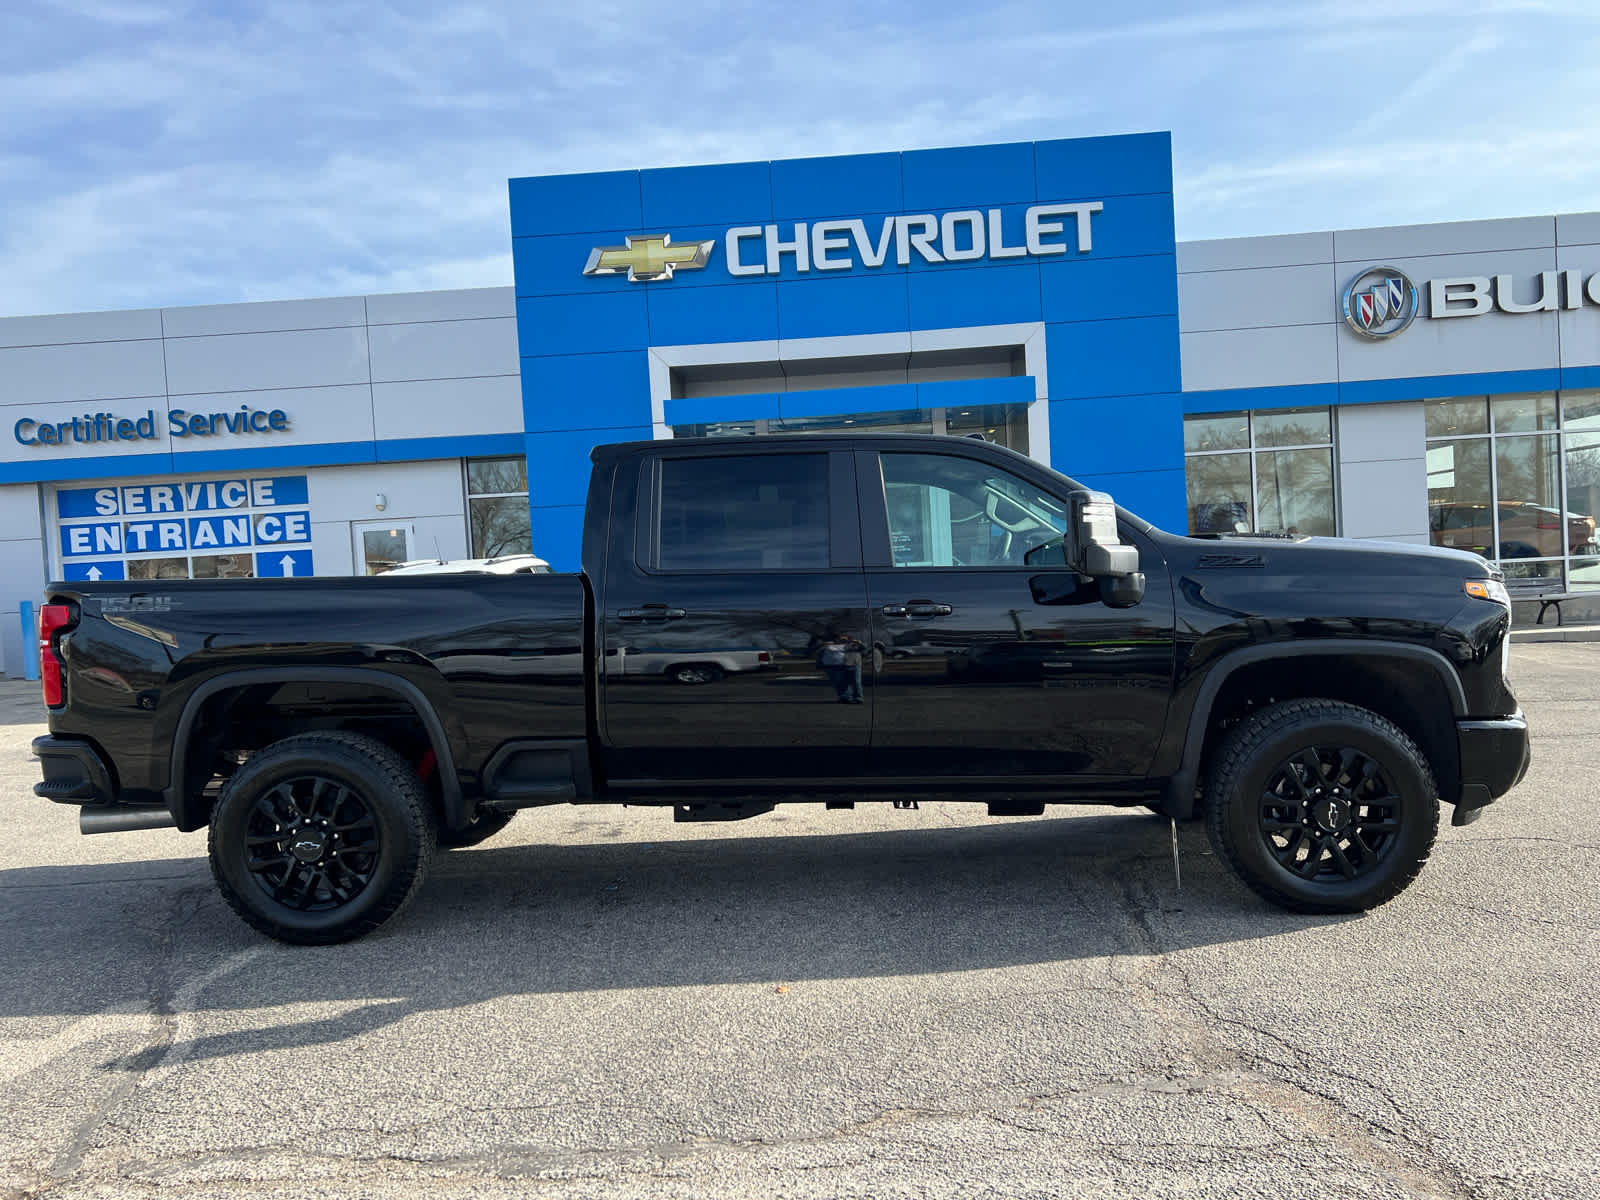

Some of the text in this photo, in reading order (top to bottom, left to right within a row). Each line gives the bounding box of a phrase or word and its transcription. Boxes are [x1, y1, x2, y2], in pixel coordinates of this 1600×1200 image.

[725, 201, 1104, 277] CHEVROLET
[1428, 270, 1600, 319] BUI
[14, 404, 288, 446] Certified Service
[94, 479, 275, 516] SERVICE
[69, 514, 308, 553] ENTRANCE
